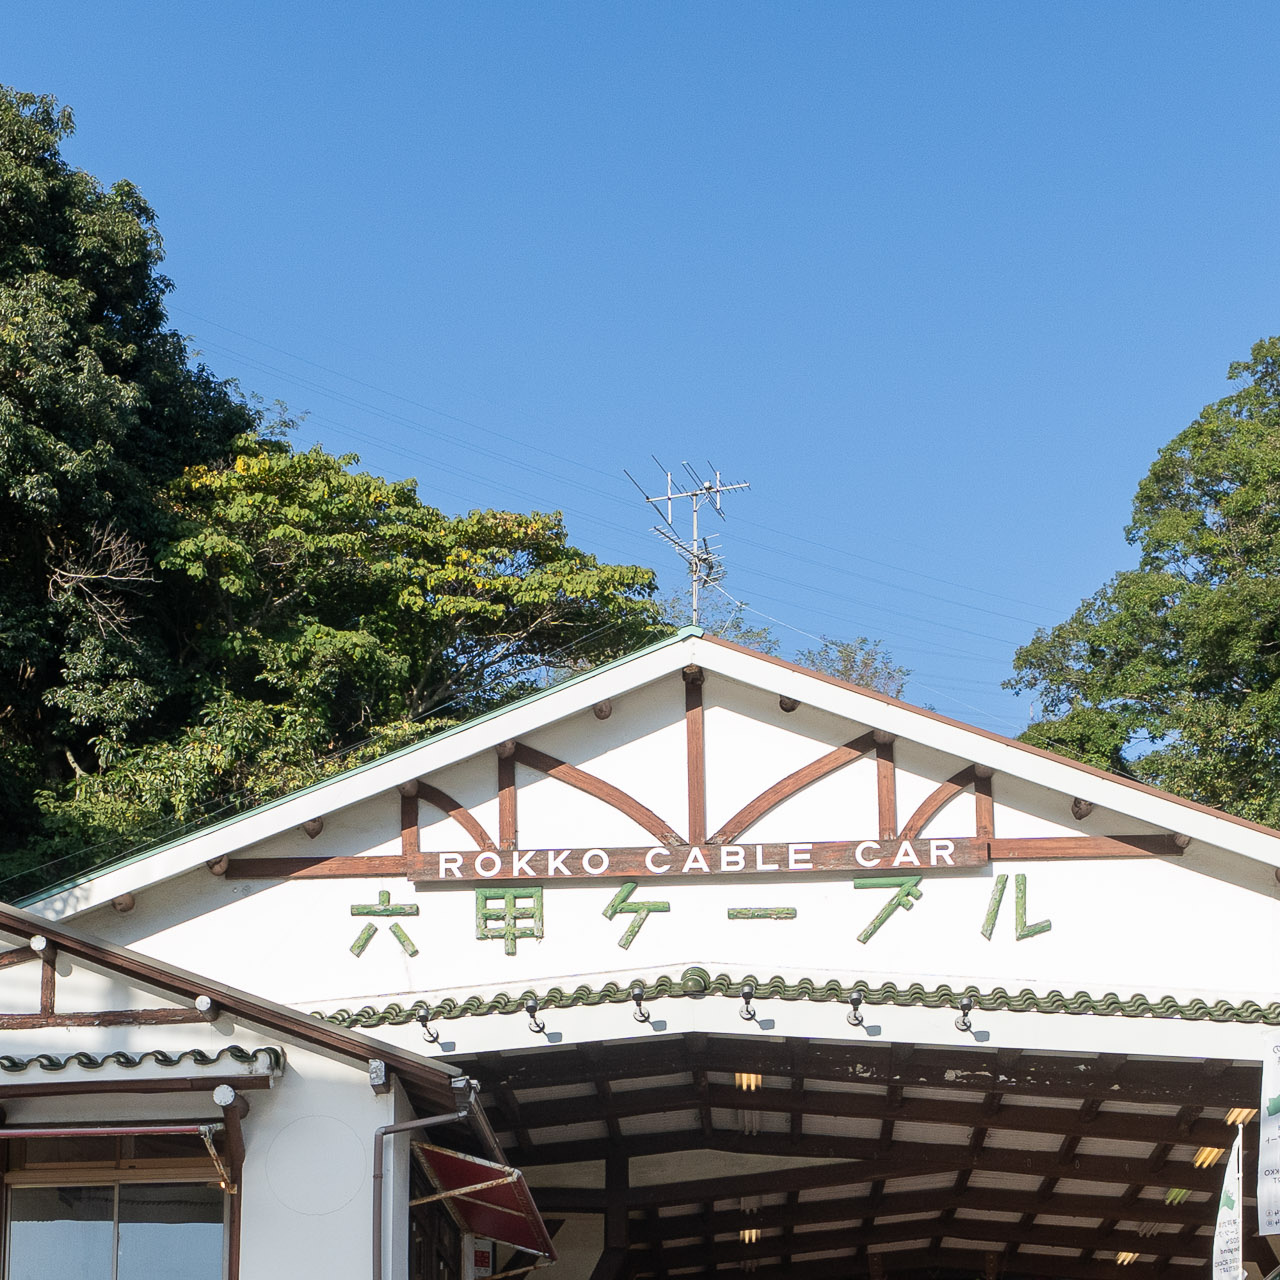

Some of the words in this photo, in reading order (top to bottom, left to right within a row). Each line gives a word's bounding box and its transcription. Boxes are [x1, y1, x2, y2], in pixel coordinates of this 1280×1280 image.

[438, 848, 611, 880] ROKKO
[645, 843, 815, 875] CABLE
[854, 838, 956, 869] CAR
[349, 873, 1052, 958] 六甲ケーブル
